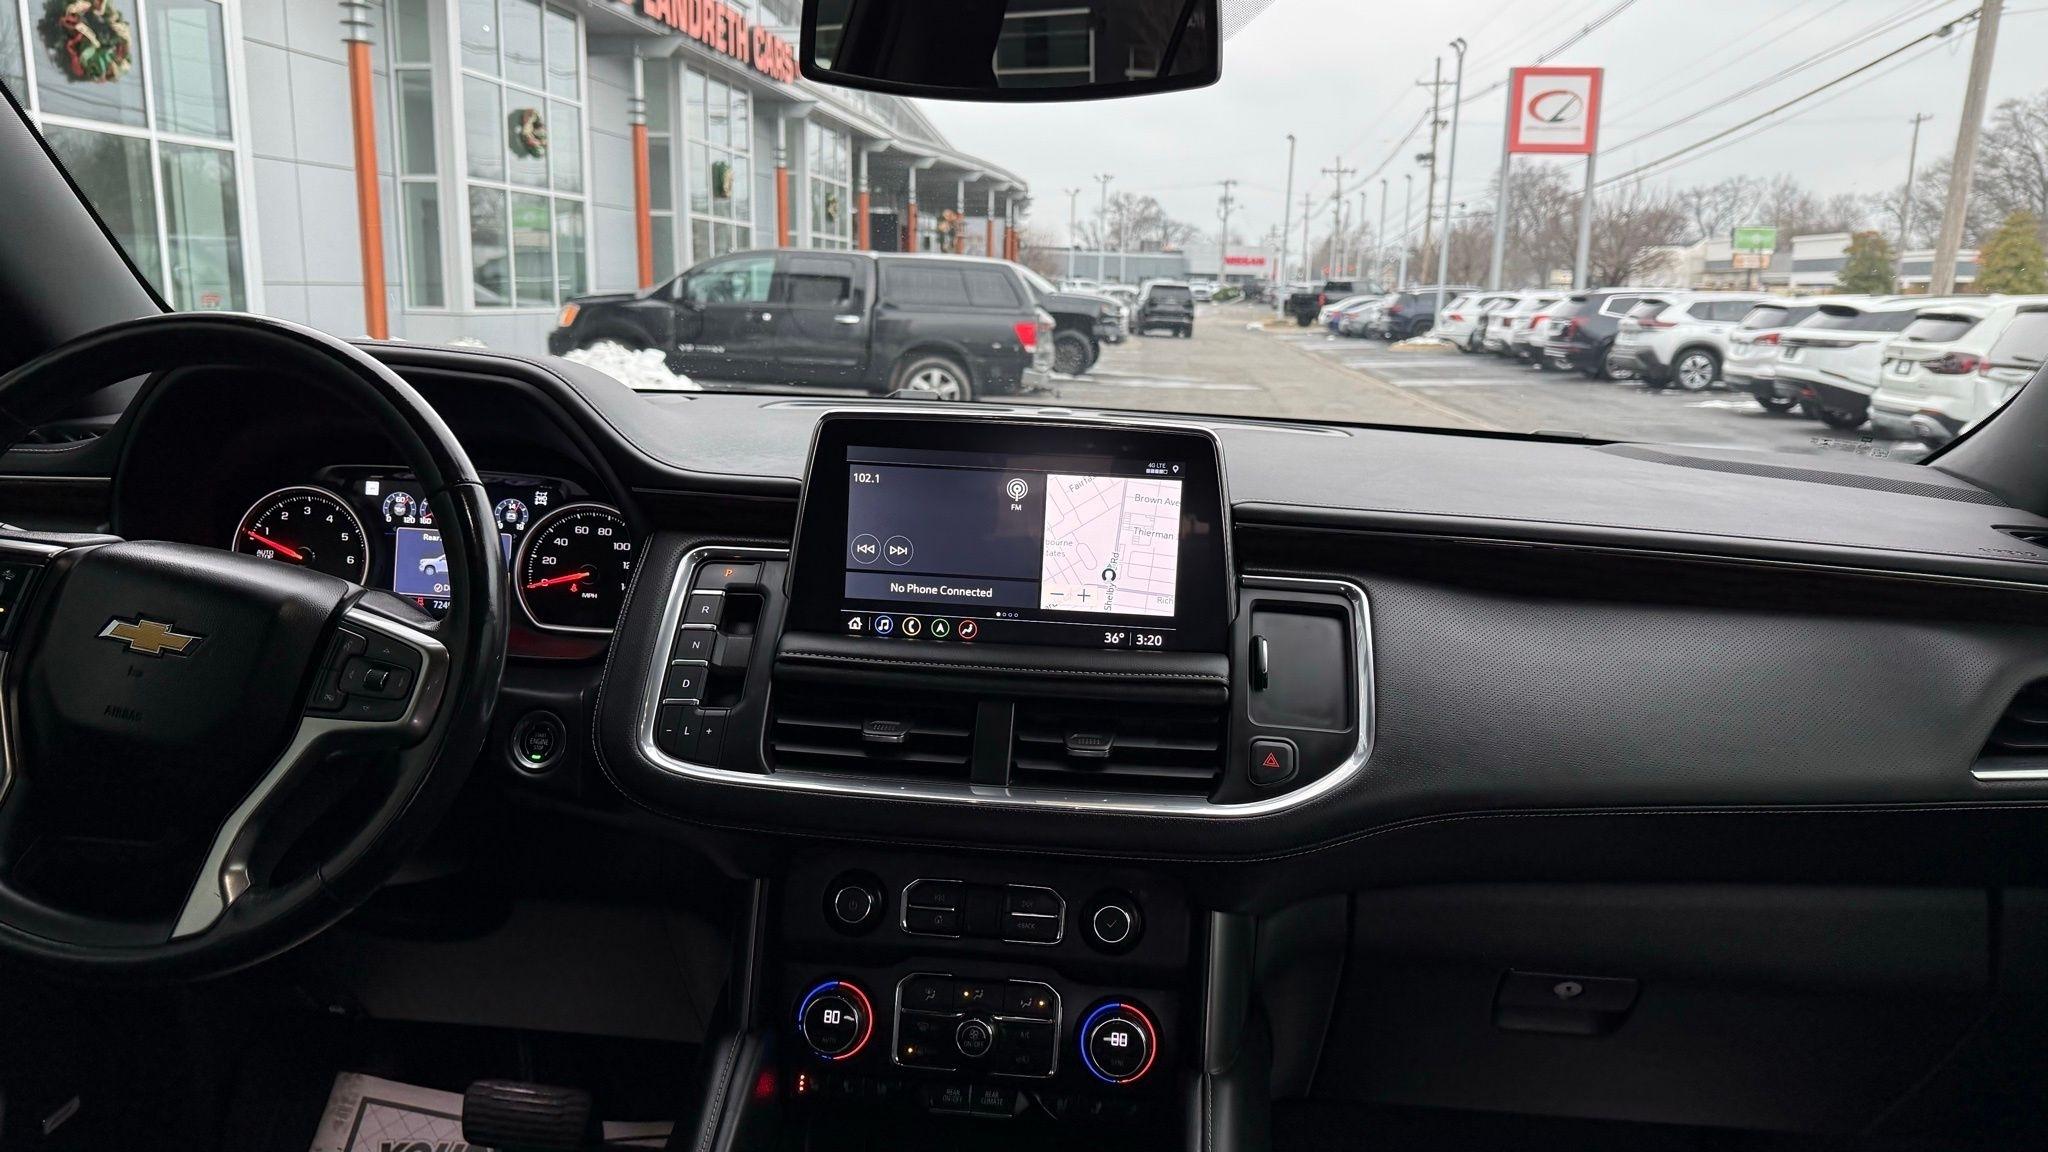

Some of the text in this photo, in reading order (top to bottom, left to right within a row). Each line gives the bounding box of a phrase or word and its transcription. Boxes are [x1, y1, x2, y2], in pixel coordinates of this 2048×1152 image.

[643, 0, 795, 85] NDRETH CARS
[853, 472, 880, 484] 102.1
[1134, 493, 1163, 505] Brown
[303, 506, 311, 515] 3
[1010, 503, 1022, 511] FM
[281, 511, 289, 520] 2
[326, 514, 334, 524] 4
[265, 526, 269, 535] 1
[574, 525, 590, 535] 60
[597, 527, 613, 536] 80
[1134, 526, 1174, 540] Thierman
[341, 532, 349, 541] 5
[553, 537, 569, 547] 40
[613, 542, 631, 551] 100
[346, 555, 354, 565] 6
[541, 556, 557, 565] 20
[1110, 552, 1120, 564] Rd
[724, 568, 734, 577] P
[890, 582, 993, 598] No Phone Connected
[433, 600, 450, 609] 724
[701, 605, 710, 614] R
[1104, 632, 1162, 646] 36° 3:20
[691, 640, 701, 650] N
[682, 679, 691, 688] D
[684, 726, 690, 736] L
[823, 1009, 841, 1025] 80
